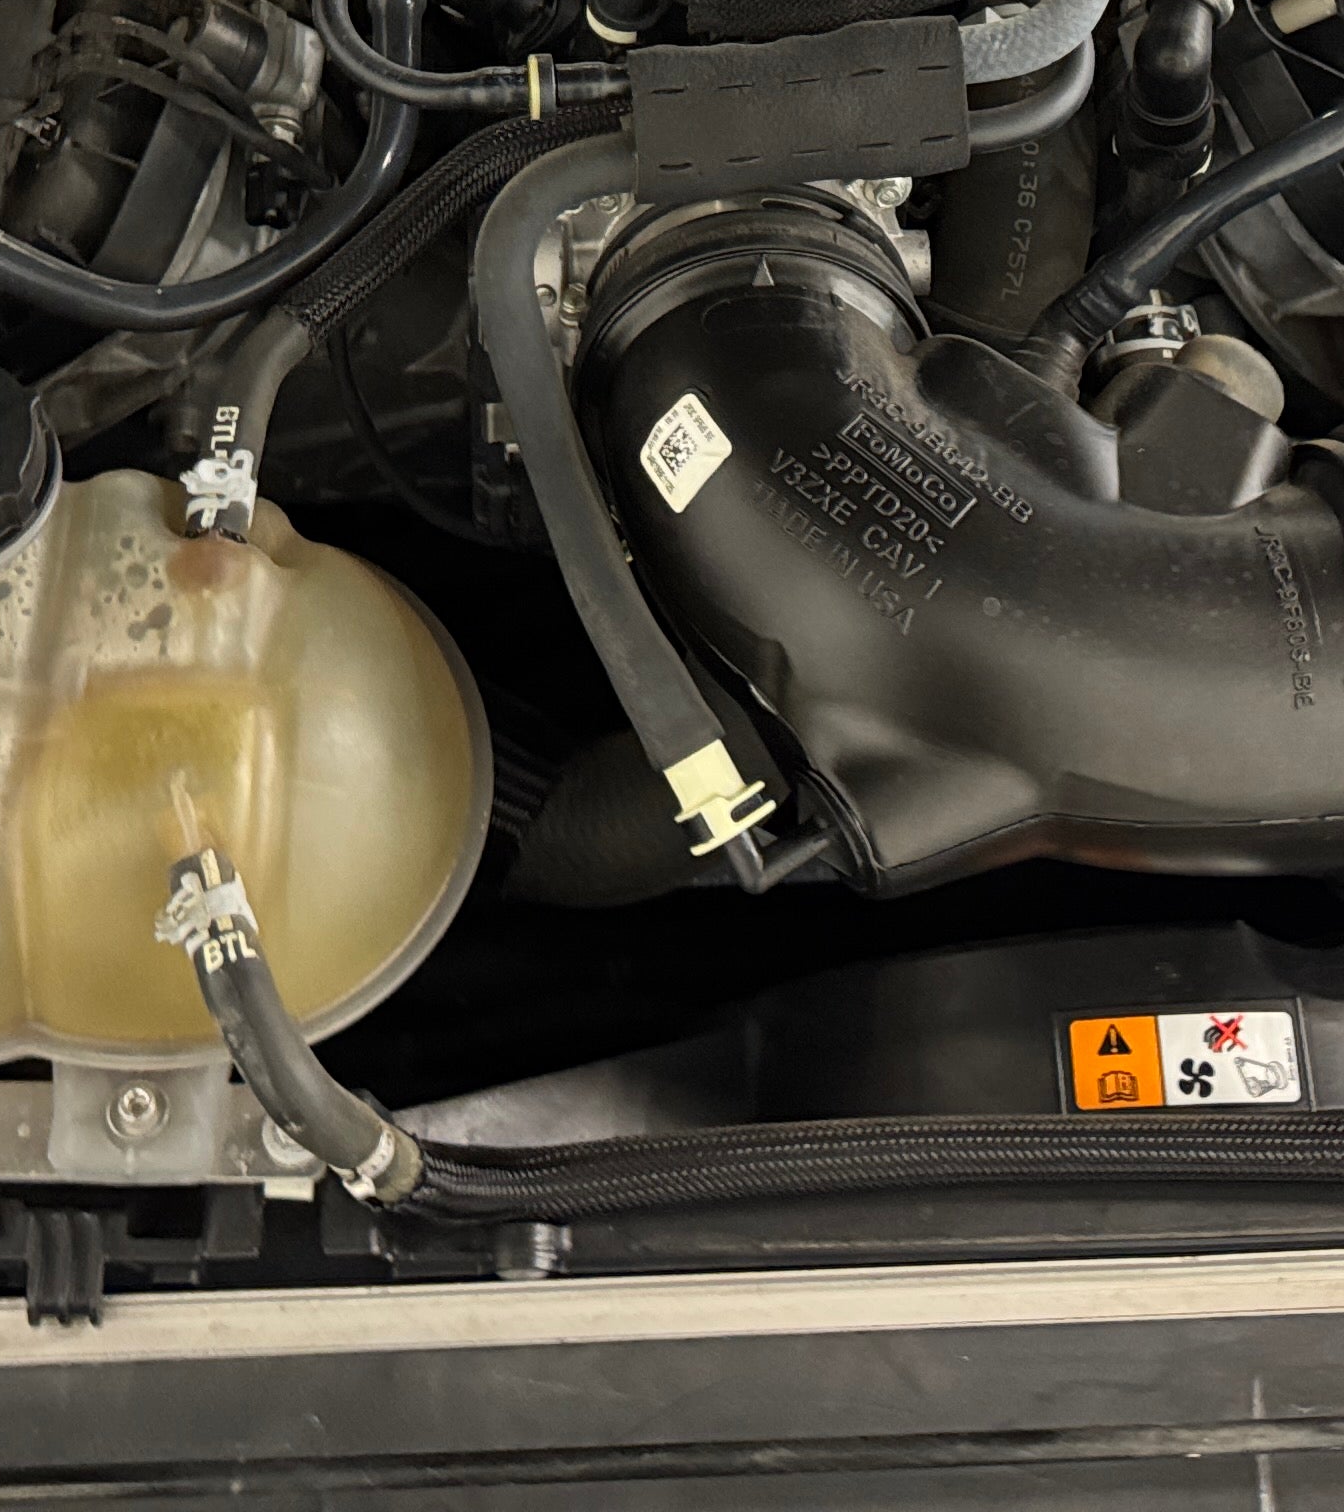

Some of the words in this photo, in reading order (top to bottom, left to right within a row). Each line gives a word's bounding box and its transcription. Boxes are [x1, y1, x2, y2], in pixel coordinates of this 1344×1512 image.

[770, 448, 858, 526] V3ZXE
[862, 524, 926, 578] CAV
[853, 422, 957, 512] FoMoCo
[827, 541, 859, 580] IN
[858, 571, 914, 636] USA
[202, 930, 258, 975] BTL
